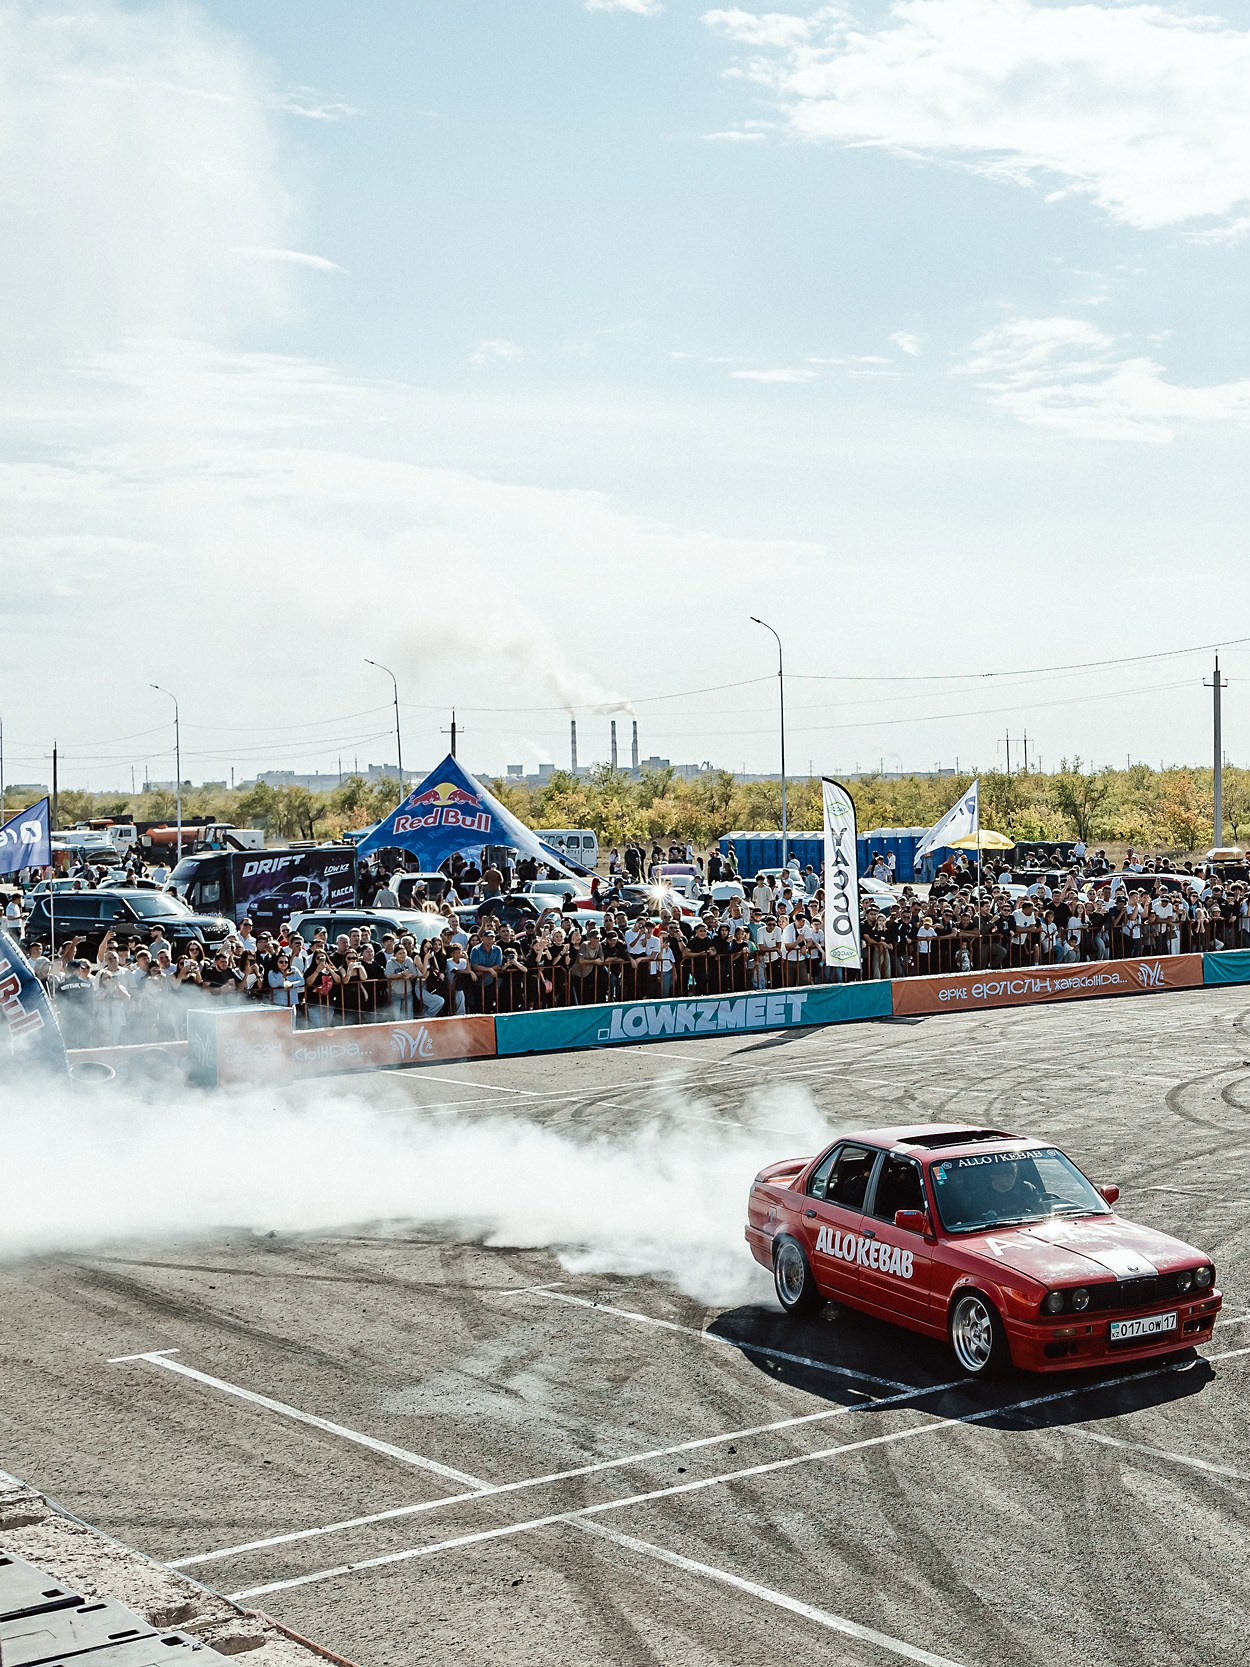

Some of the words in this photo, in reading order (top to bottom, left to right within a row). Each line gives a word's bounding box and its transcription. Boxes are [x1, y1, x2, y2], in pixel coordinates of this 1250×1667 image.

[393, 807, 441, 835] Red
[441, 807, 492, 833] Bull
[242, 854, 306, 878] DRIFT
[609, 993, 808, 1040] LOWKZMEET
[958, 1156, 992, 1168] ALLO
[999, 1149, 1043, 1162] KEBAB
